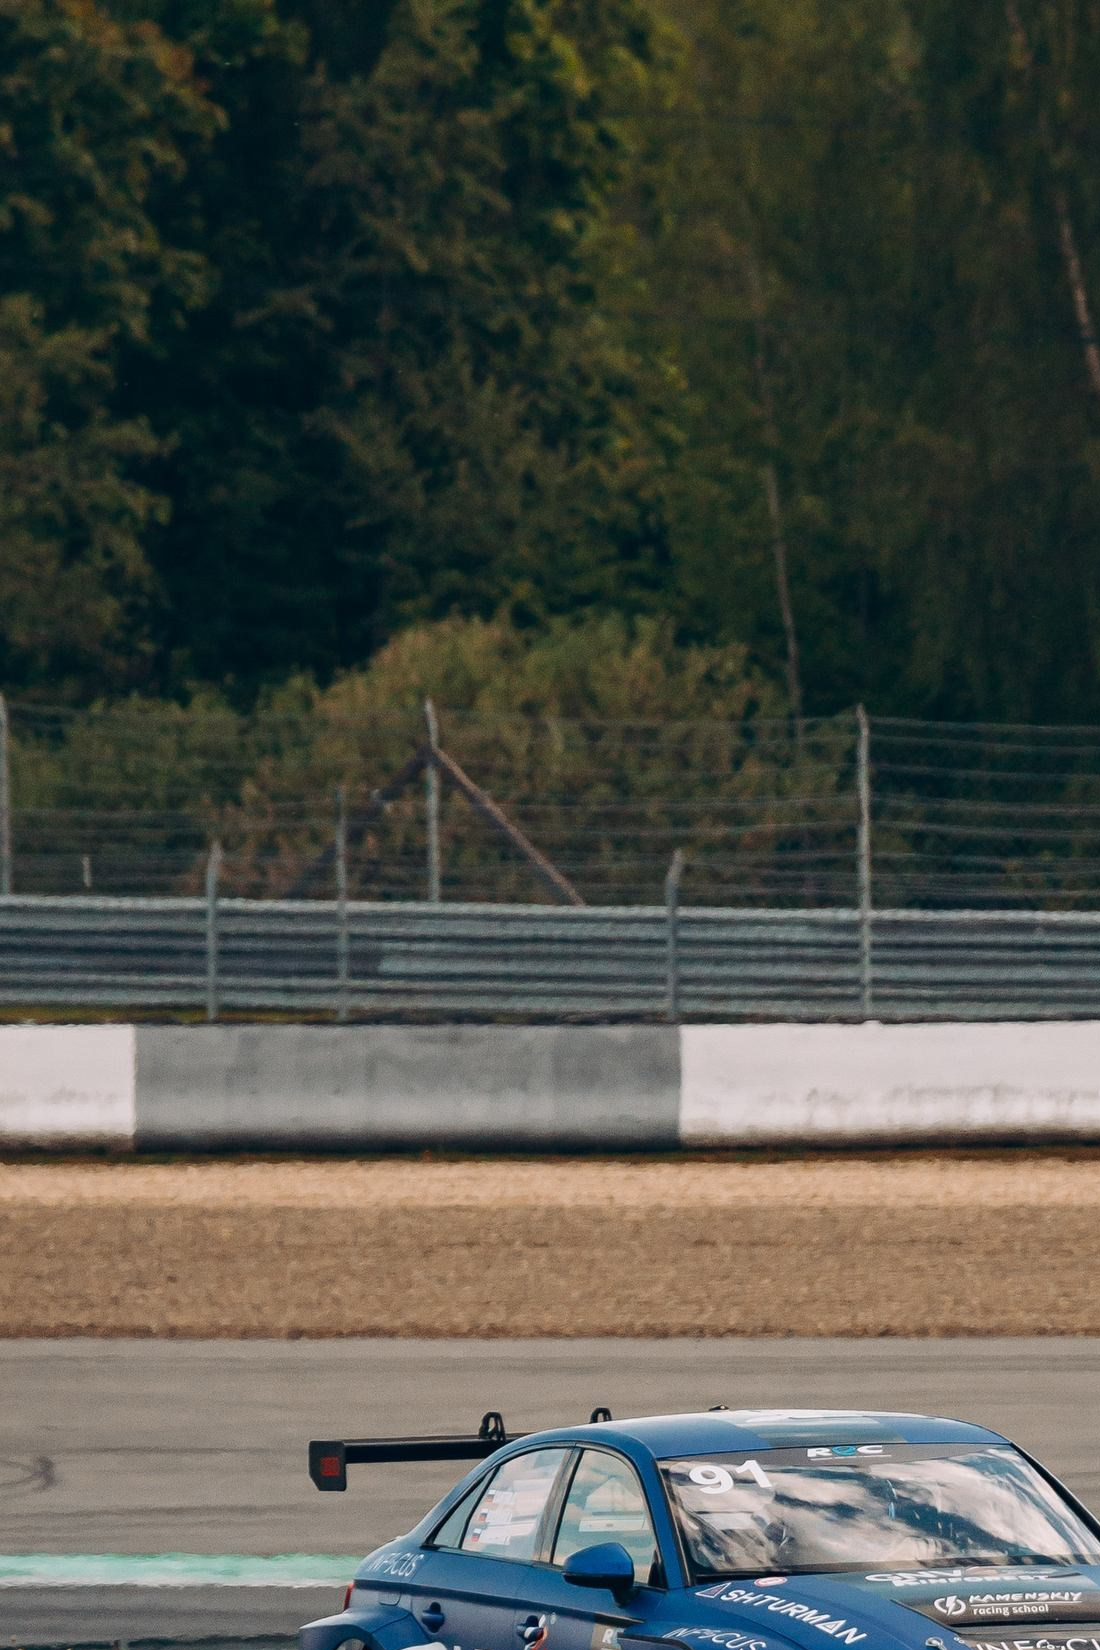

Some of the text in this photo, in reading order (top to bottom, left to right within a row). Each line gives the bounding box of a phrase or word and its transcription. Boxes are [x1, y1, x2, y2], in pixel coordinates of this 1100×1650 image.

[688, 1459, 773, 1495] 91
[968, 1591, 1083, 1602] KAMENSKIY
[720, 1589, 868, 1645] SHTURMAN
[973, 1603, 1049, 1616] racing school
